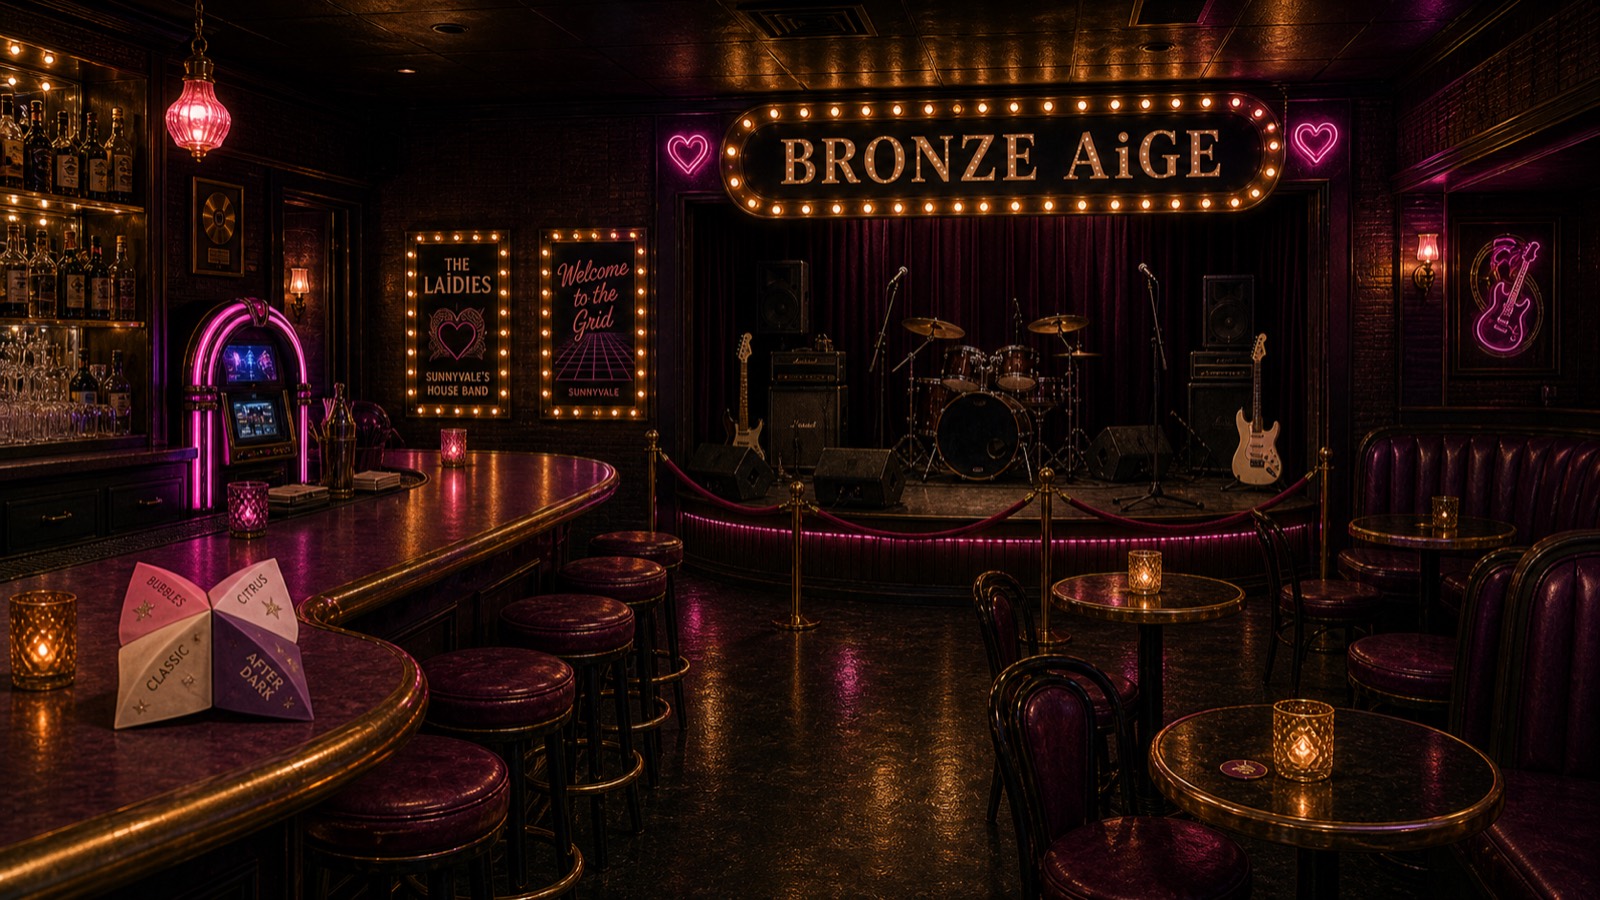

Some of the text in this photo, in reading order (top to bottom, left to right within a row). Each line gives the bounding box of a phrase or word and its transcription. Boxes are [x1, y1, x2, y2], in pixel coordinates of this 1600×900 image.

[780, 127, 1222, 185] BRONZE AiGE
[443, 257, 470, 272] THE
[557, 259, 630, 288] Welcome
[573, 281, 619, 308] to the
[573, 305, 615, 342] Grid
[425, 371, 491, 383] SUNNYVALE'S
[427, 385, 489, 397] HOUSE BAND
[568, 387, 620, 398] SUNNYVALE
[146, 575, 187, 608] BUBBLES
[237, 573, 268, 605] CITRUS
[146, 644, 190, 692] CLASSIC
[239, 665, 275, 702] DARK
[245, 652, 284, 691] AFTER
